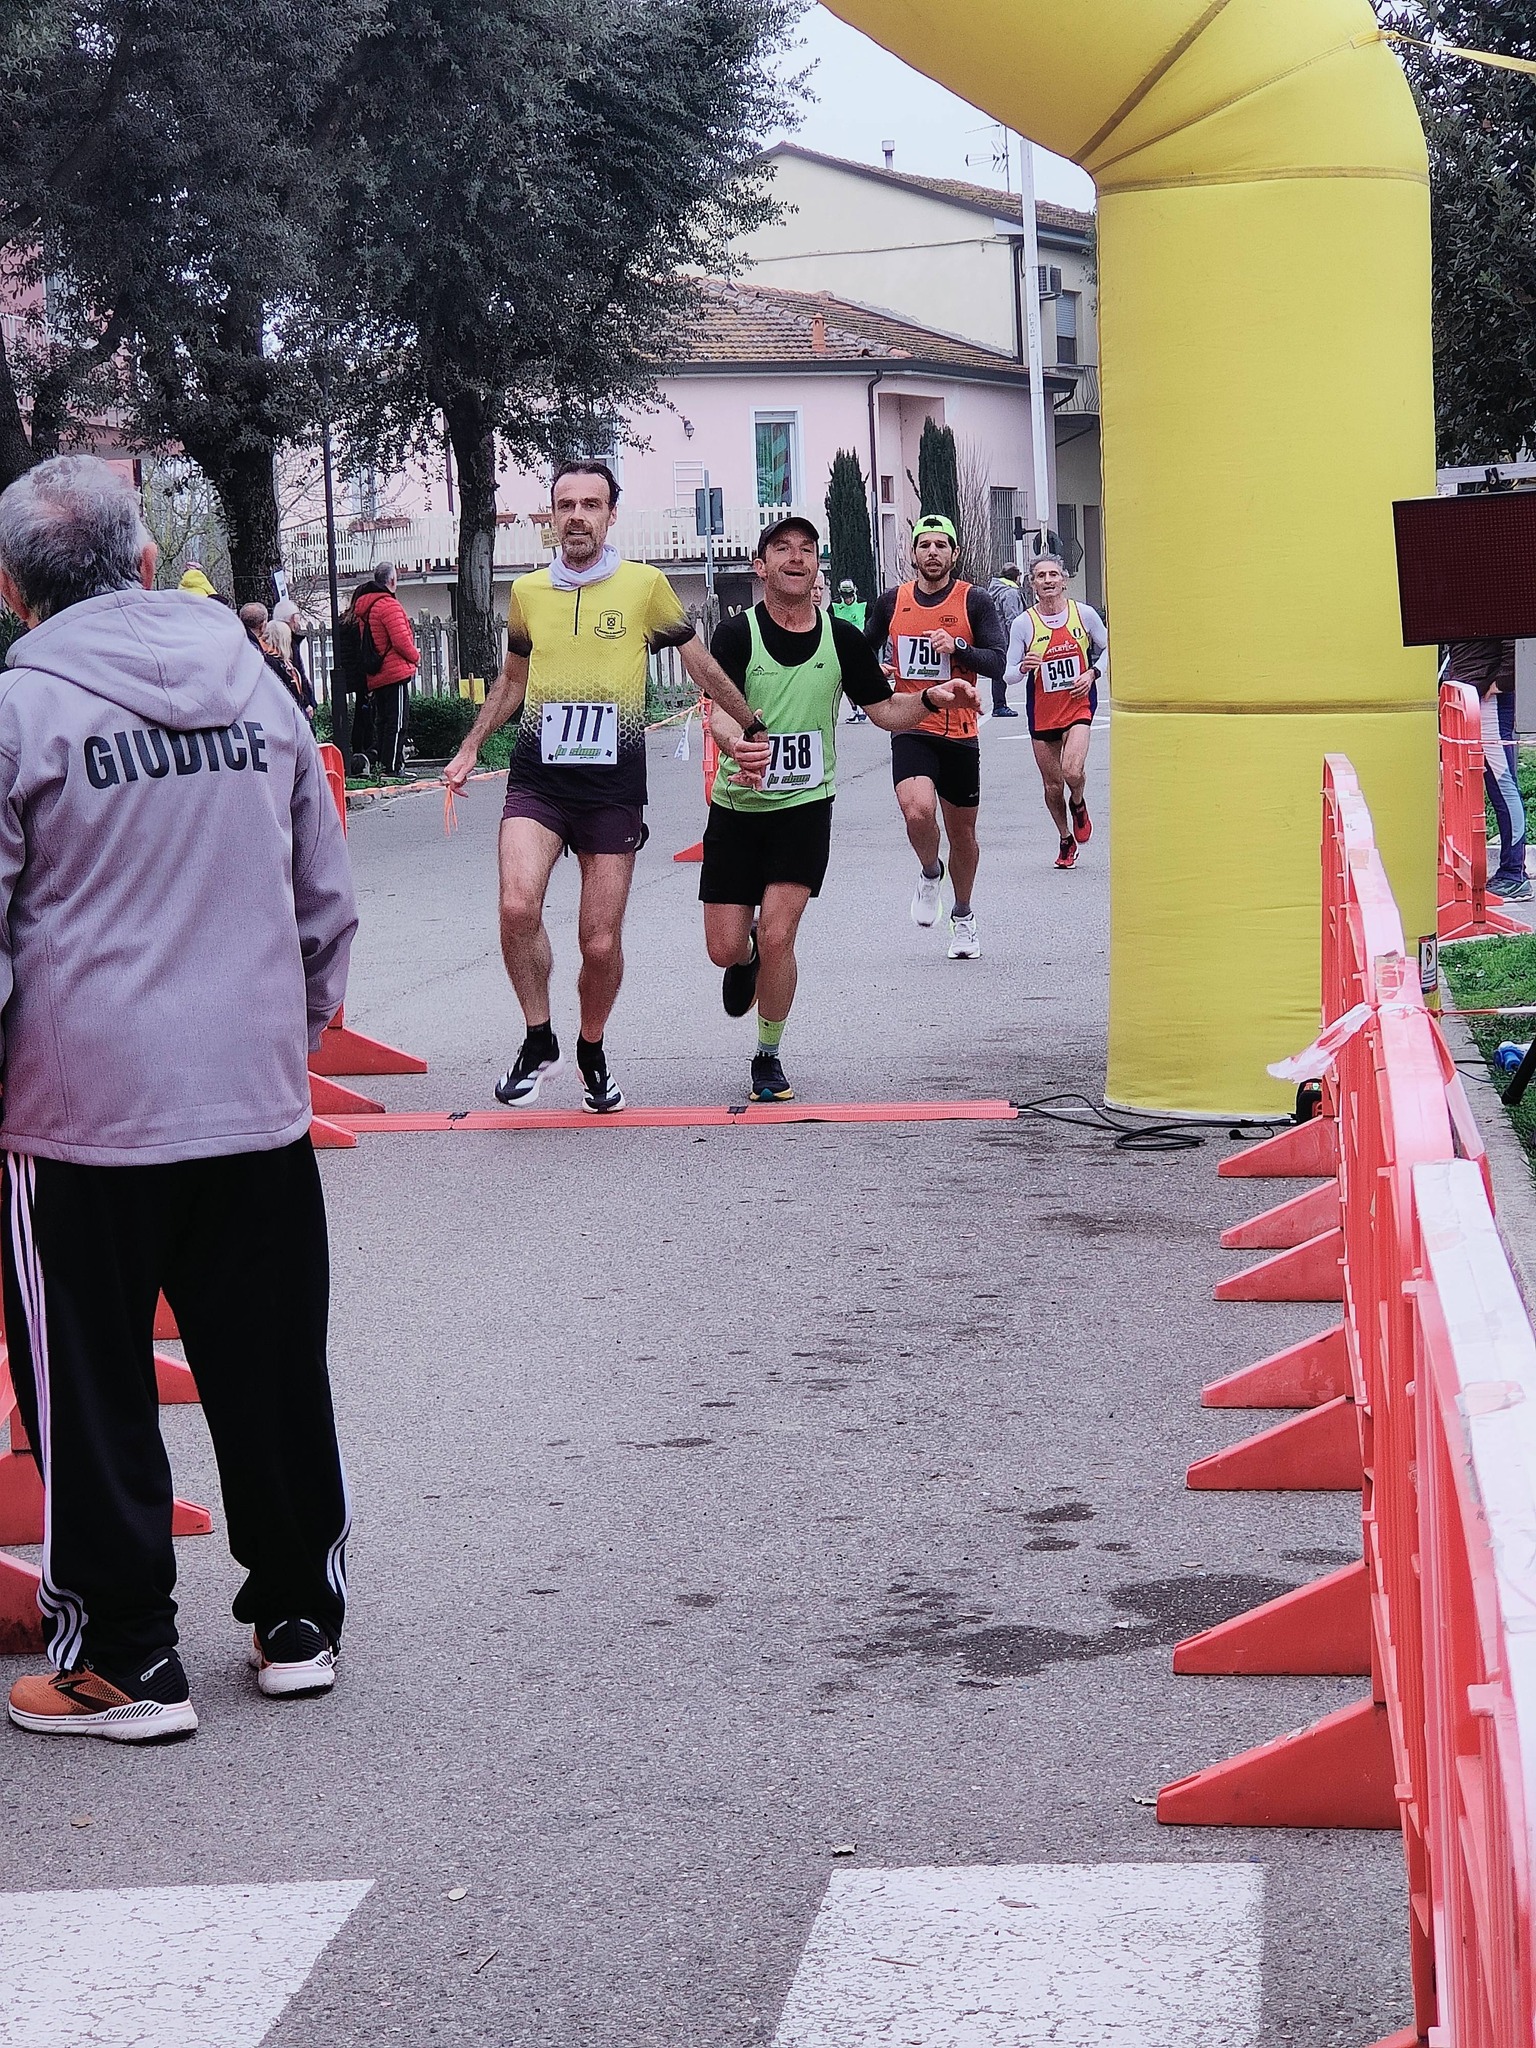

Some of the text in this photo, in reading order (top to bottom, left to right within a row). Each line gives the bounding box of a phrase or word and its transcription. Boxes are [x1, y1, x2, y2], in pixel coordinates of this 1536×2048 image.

[1047, 659, 1075, 681] 540
[561, 705, 604, 742] 777
[84, 721, 268, 789] GIUDICE
[768, 734, 812, 771] 758
